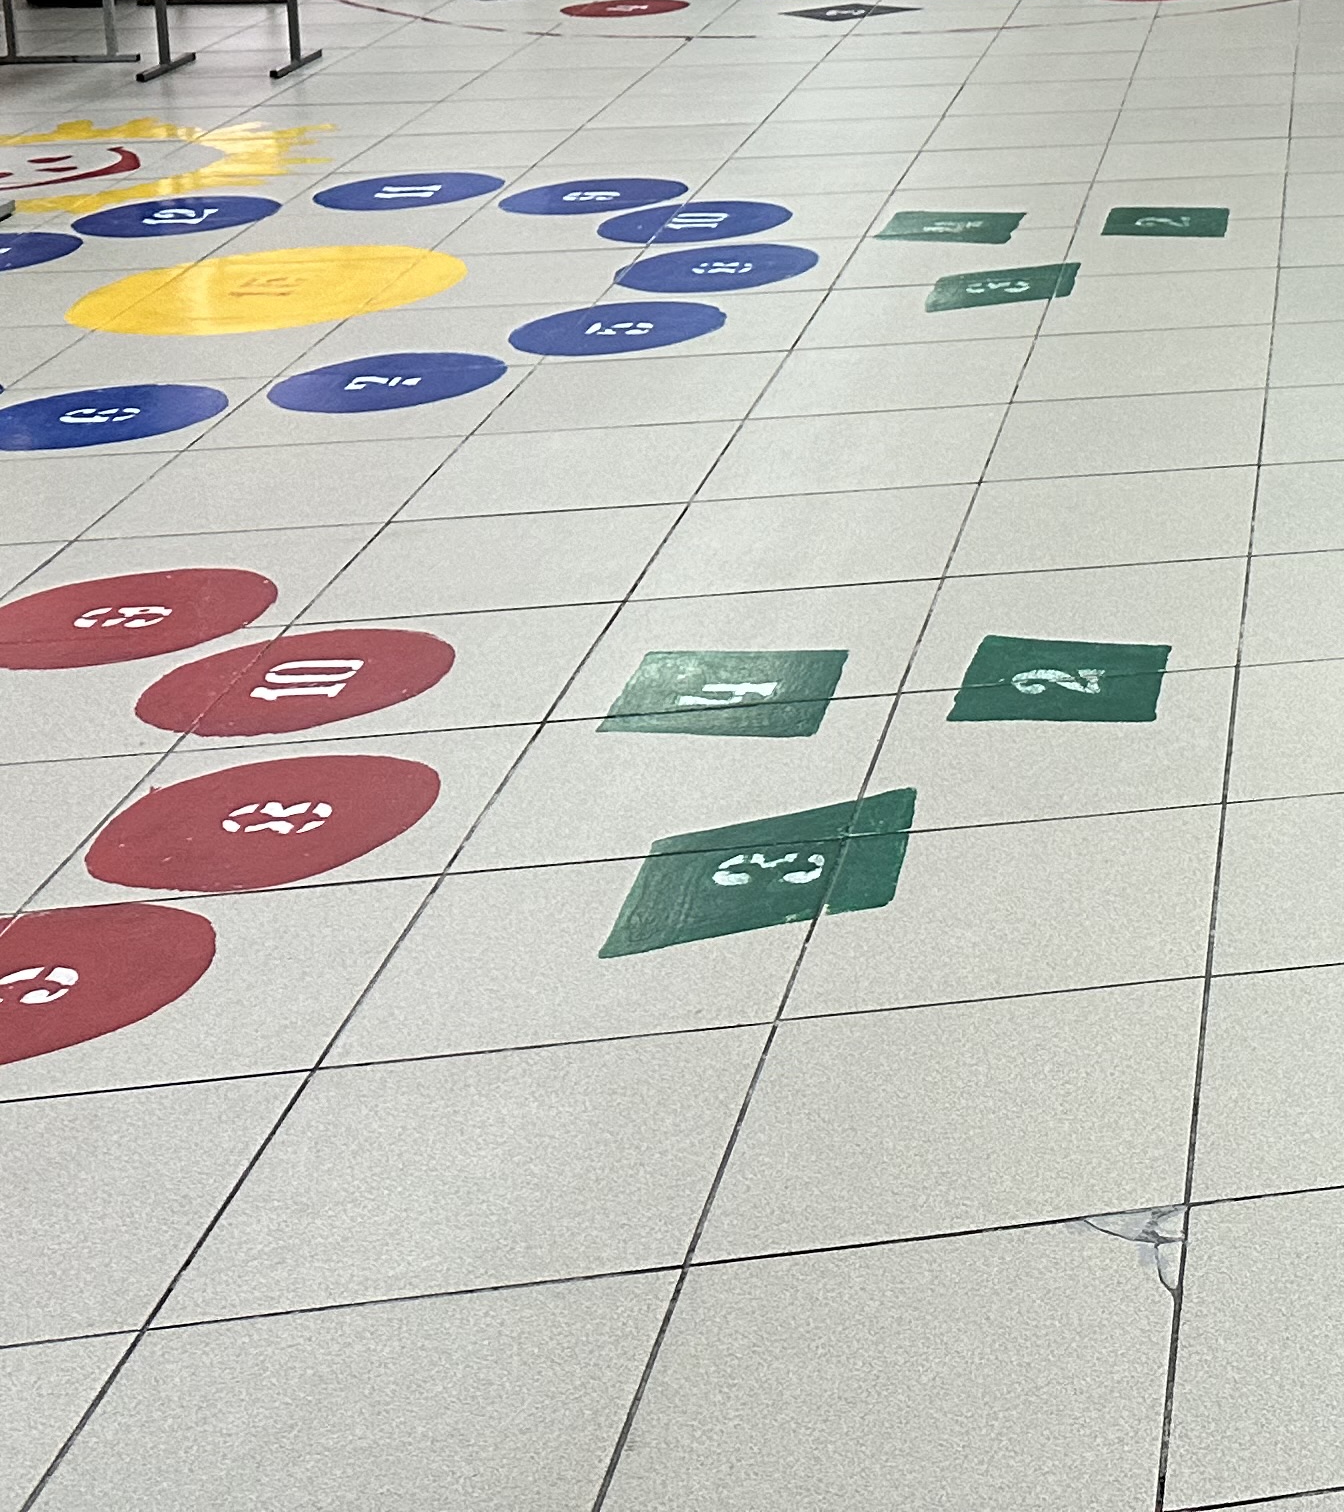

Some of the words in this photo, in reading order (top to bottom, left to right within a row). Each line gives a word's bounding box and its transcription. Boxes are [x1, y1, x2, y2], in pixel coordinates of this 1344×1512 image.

[373, 183, 443, 201] 11
[142, 207, 220, 227] 12
[665, 213, 729, 229] 10
[1135, 217, 1190, 227] 2
[692, 262, 752, 274] 8
[965, 278, 1031, 294] 3
[250, 660, 364, 700] 10
[1011, 669, 1100, 694] 2
[677, 680, 779, 707] 4
[223, 802, 332, 834] 8
[712, 853, 824, 886] 3
